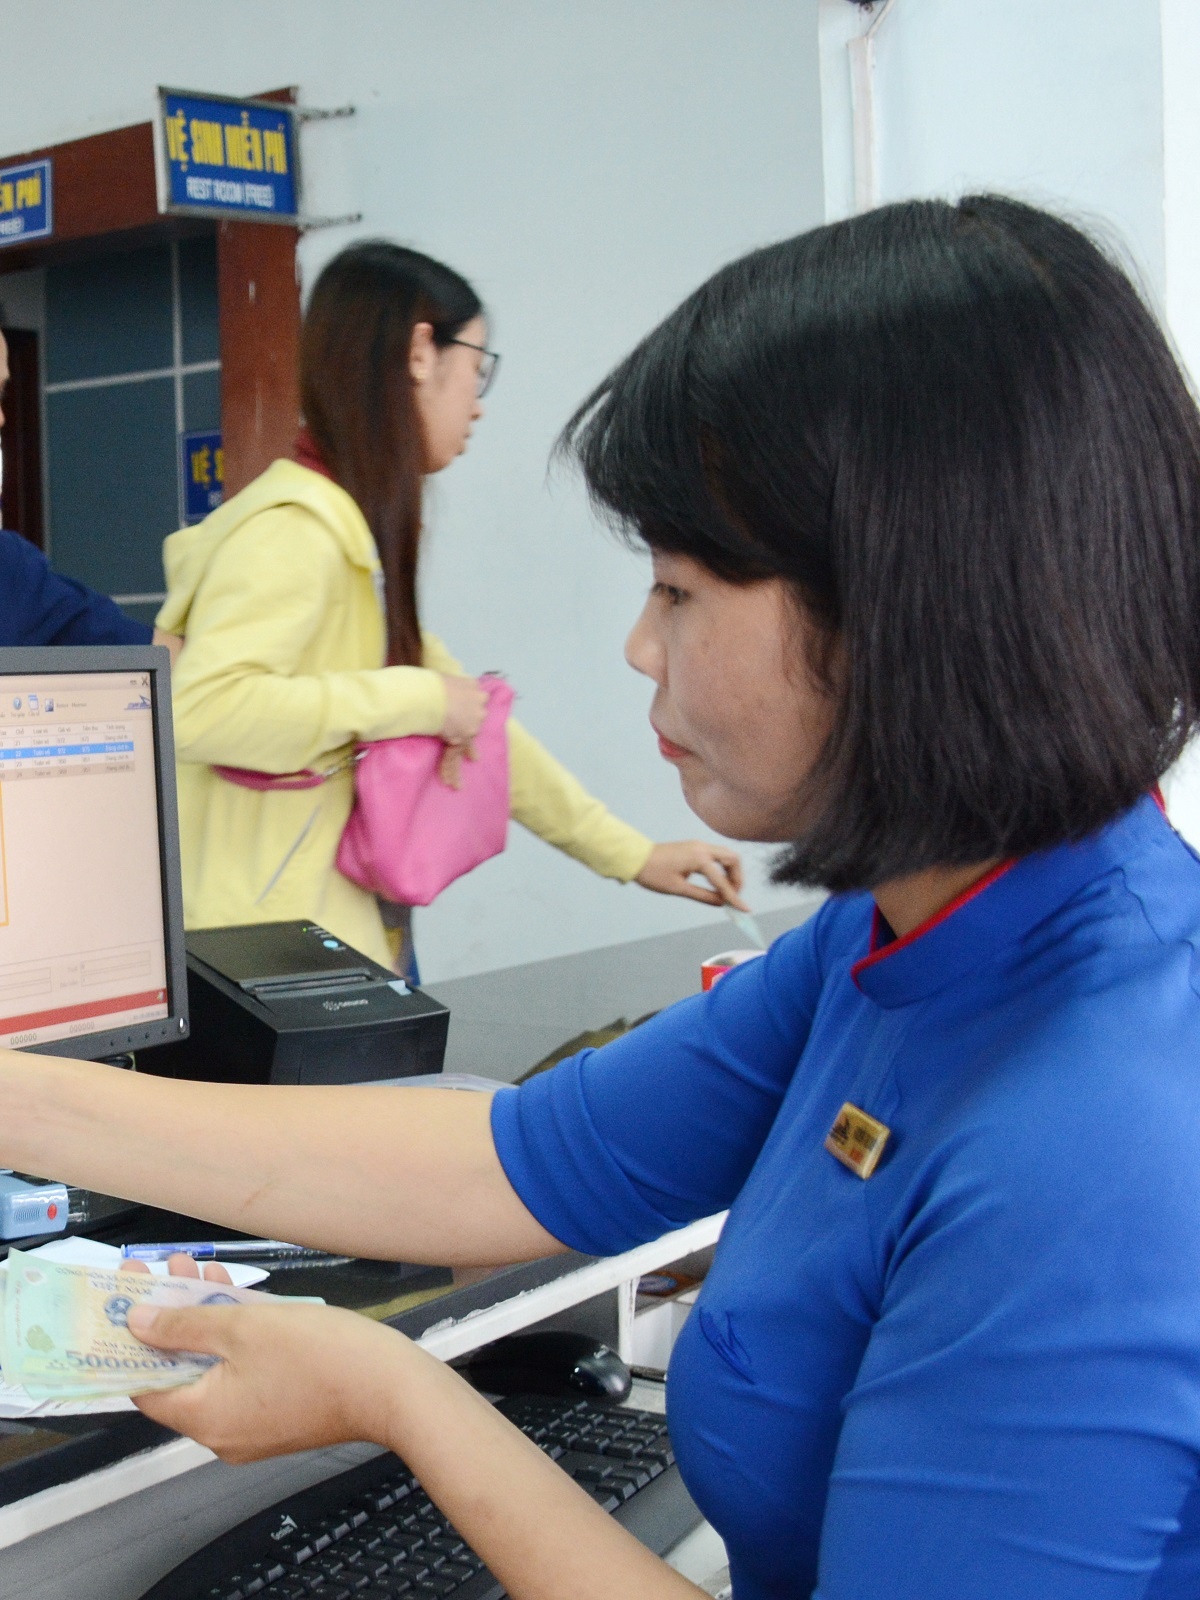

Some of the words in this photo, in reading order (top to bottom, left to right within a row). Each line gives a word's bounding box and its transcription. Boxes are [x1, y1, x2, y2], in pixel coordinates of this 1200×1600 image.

[190, 118, 225, 166] SINH
[186, 176, 212, 200] REST
[212, 179, 243, 204] ROOM
[10, 1033, 38, 1046] 000000
[65, 1350, 178, 1369] 500000
